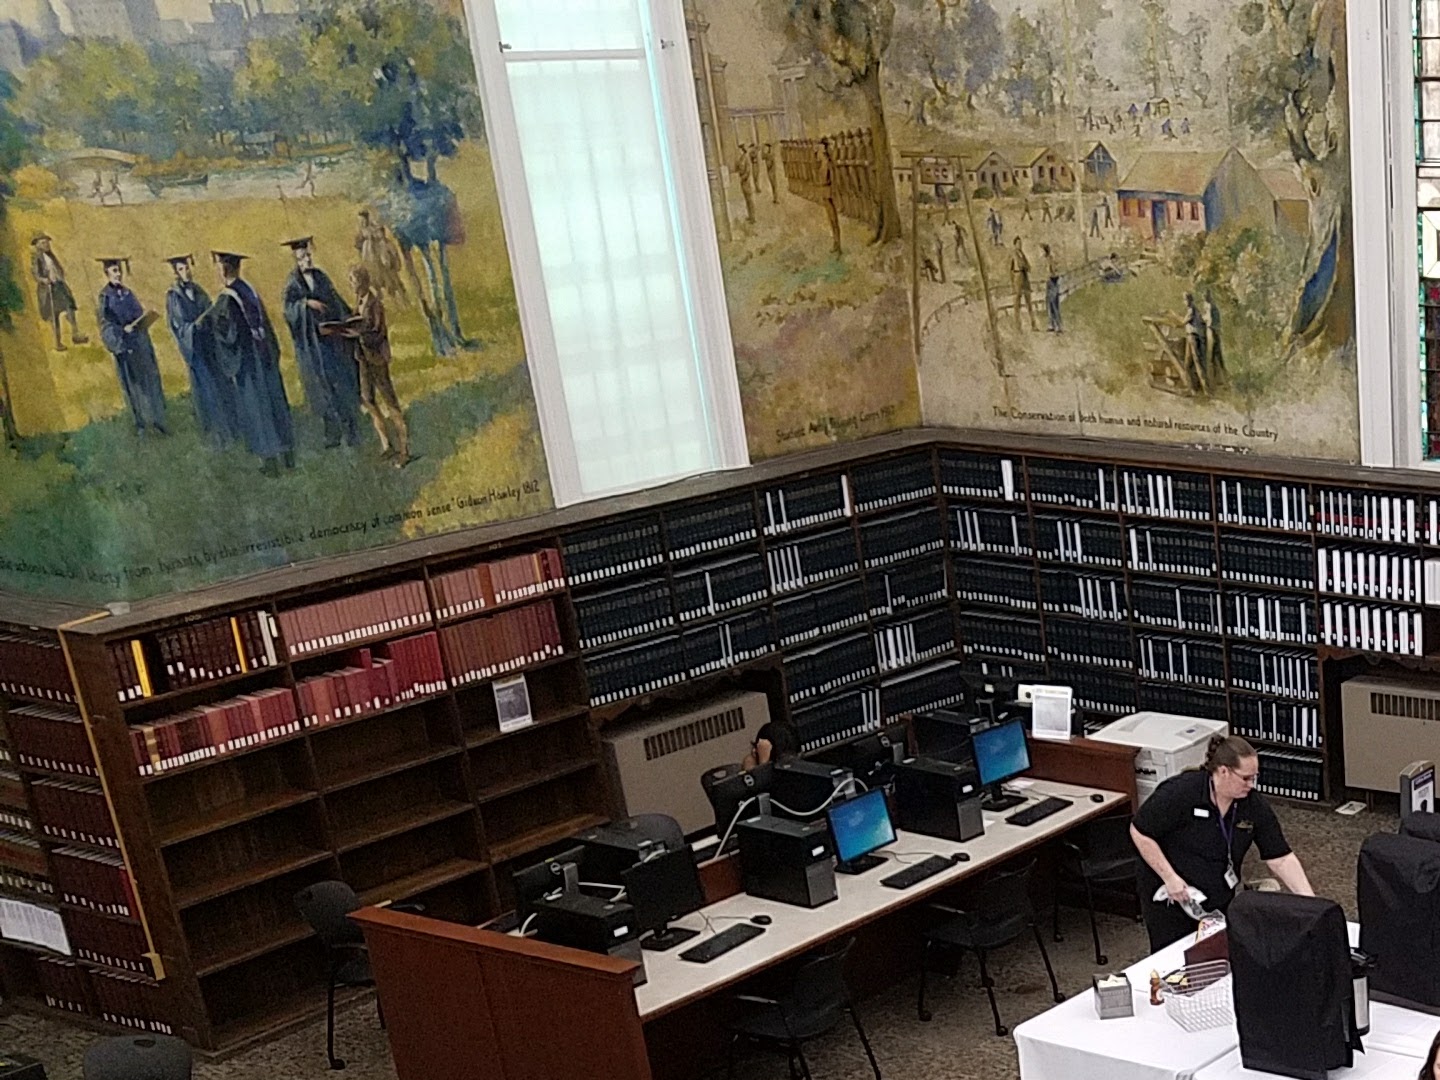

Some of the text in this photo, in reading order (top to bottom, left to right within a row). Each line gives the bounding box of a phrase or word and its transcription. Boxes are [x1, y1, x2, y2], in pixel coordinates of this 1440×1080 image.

[992, 406, 1010, 418] The
[1011, 406, 1067, 422] Conservation
[1079, 410, 1097, 424] both
[1127, 414, 1142, 427] and
[1144, 416, 1173, 430] natural
[1174, 420, 1211, 434] resources
[1213, 422, 1221, 435] of
[1224, 424, 1238, 437] the
[1243, 424, 1279, 442] Country
[203, 550, 219, 565] by
[219, 543, 239, 559] the
[310, 519, 368, 540] democracy
